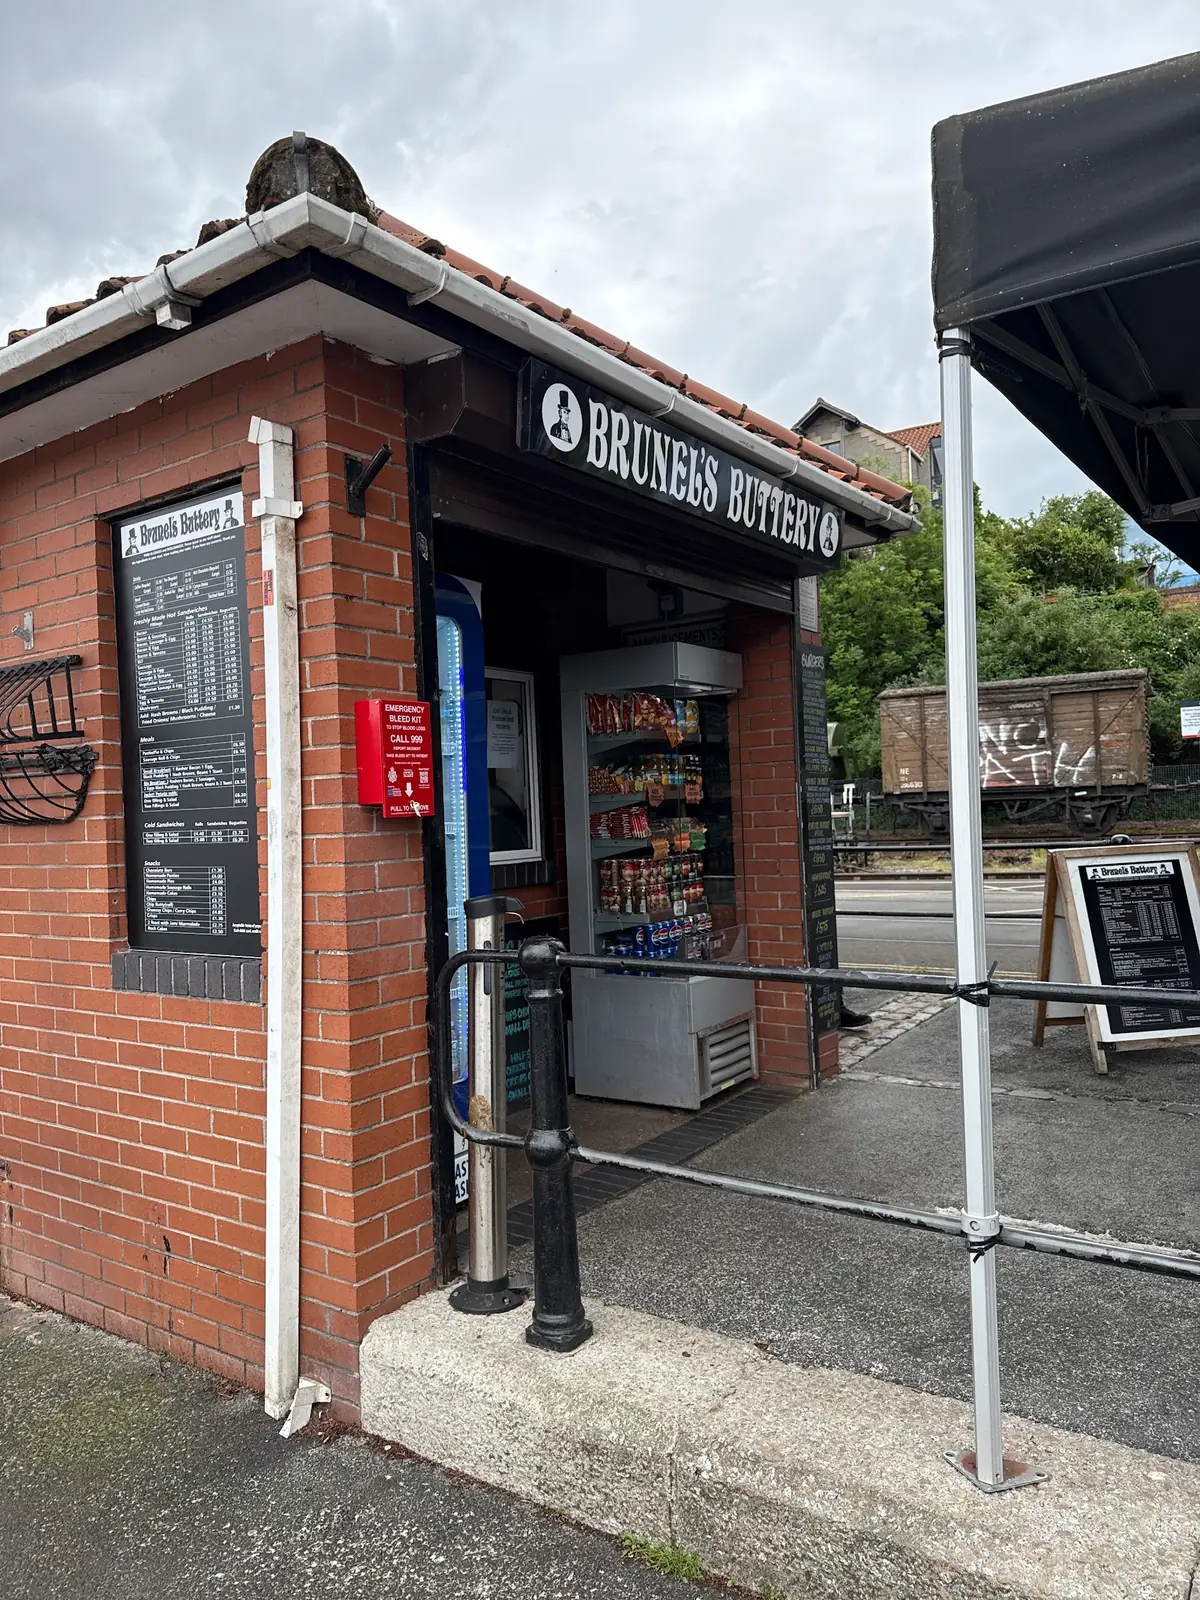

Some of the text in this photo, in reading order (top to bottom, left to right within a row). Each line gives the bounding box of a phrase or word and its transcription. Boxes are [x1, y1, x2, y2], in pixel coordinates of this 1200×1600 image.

[586, 398, 821, 553] BRUNEL'S BUTTERY
[140, 516, 178, 546] Brunel's
[180, 508, 220, 535] Buttery
[134, 616, 150, 626] Freshly
[177, 606, 208, 617] Sandwiches
[802, 652, 825, 670] BURGERS
[385, 704, 424, 713] EMERGENCY
[390, 734, 423, 743] CALL 999
[156, 820, 185, 828] Sandwiches
[1130, 866, 1158, 874] Buttery
[510, 1050, 526, 1064] HALF
